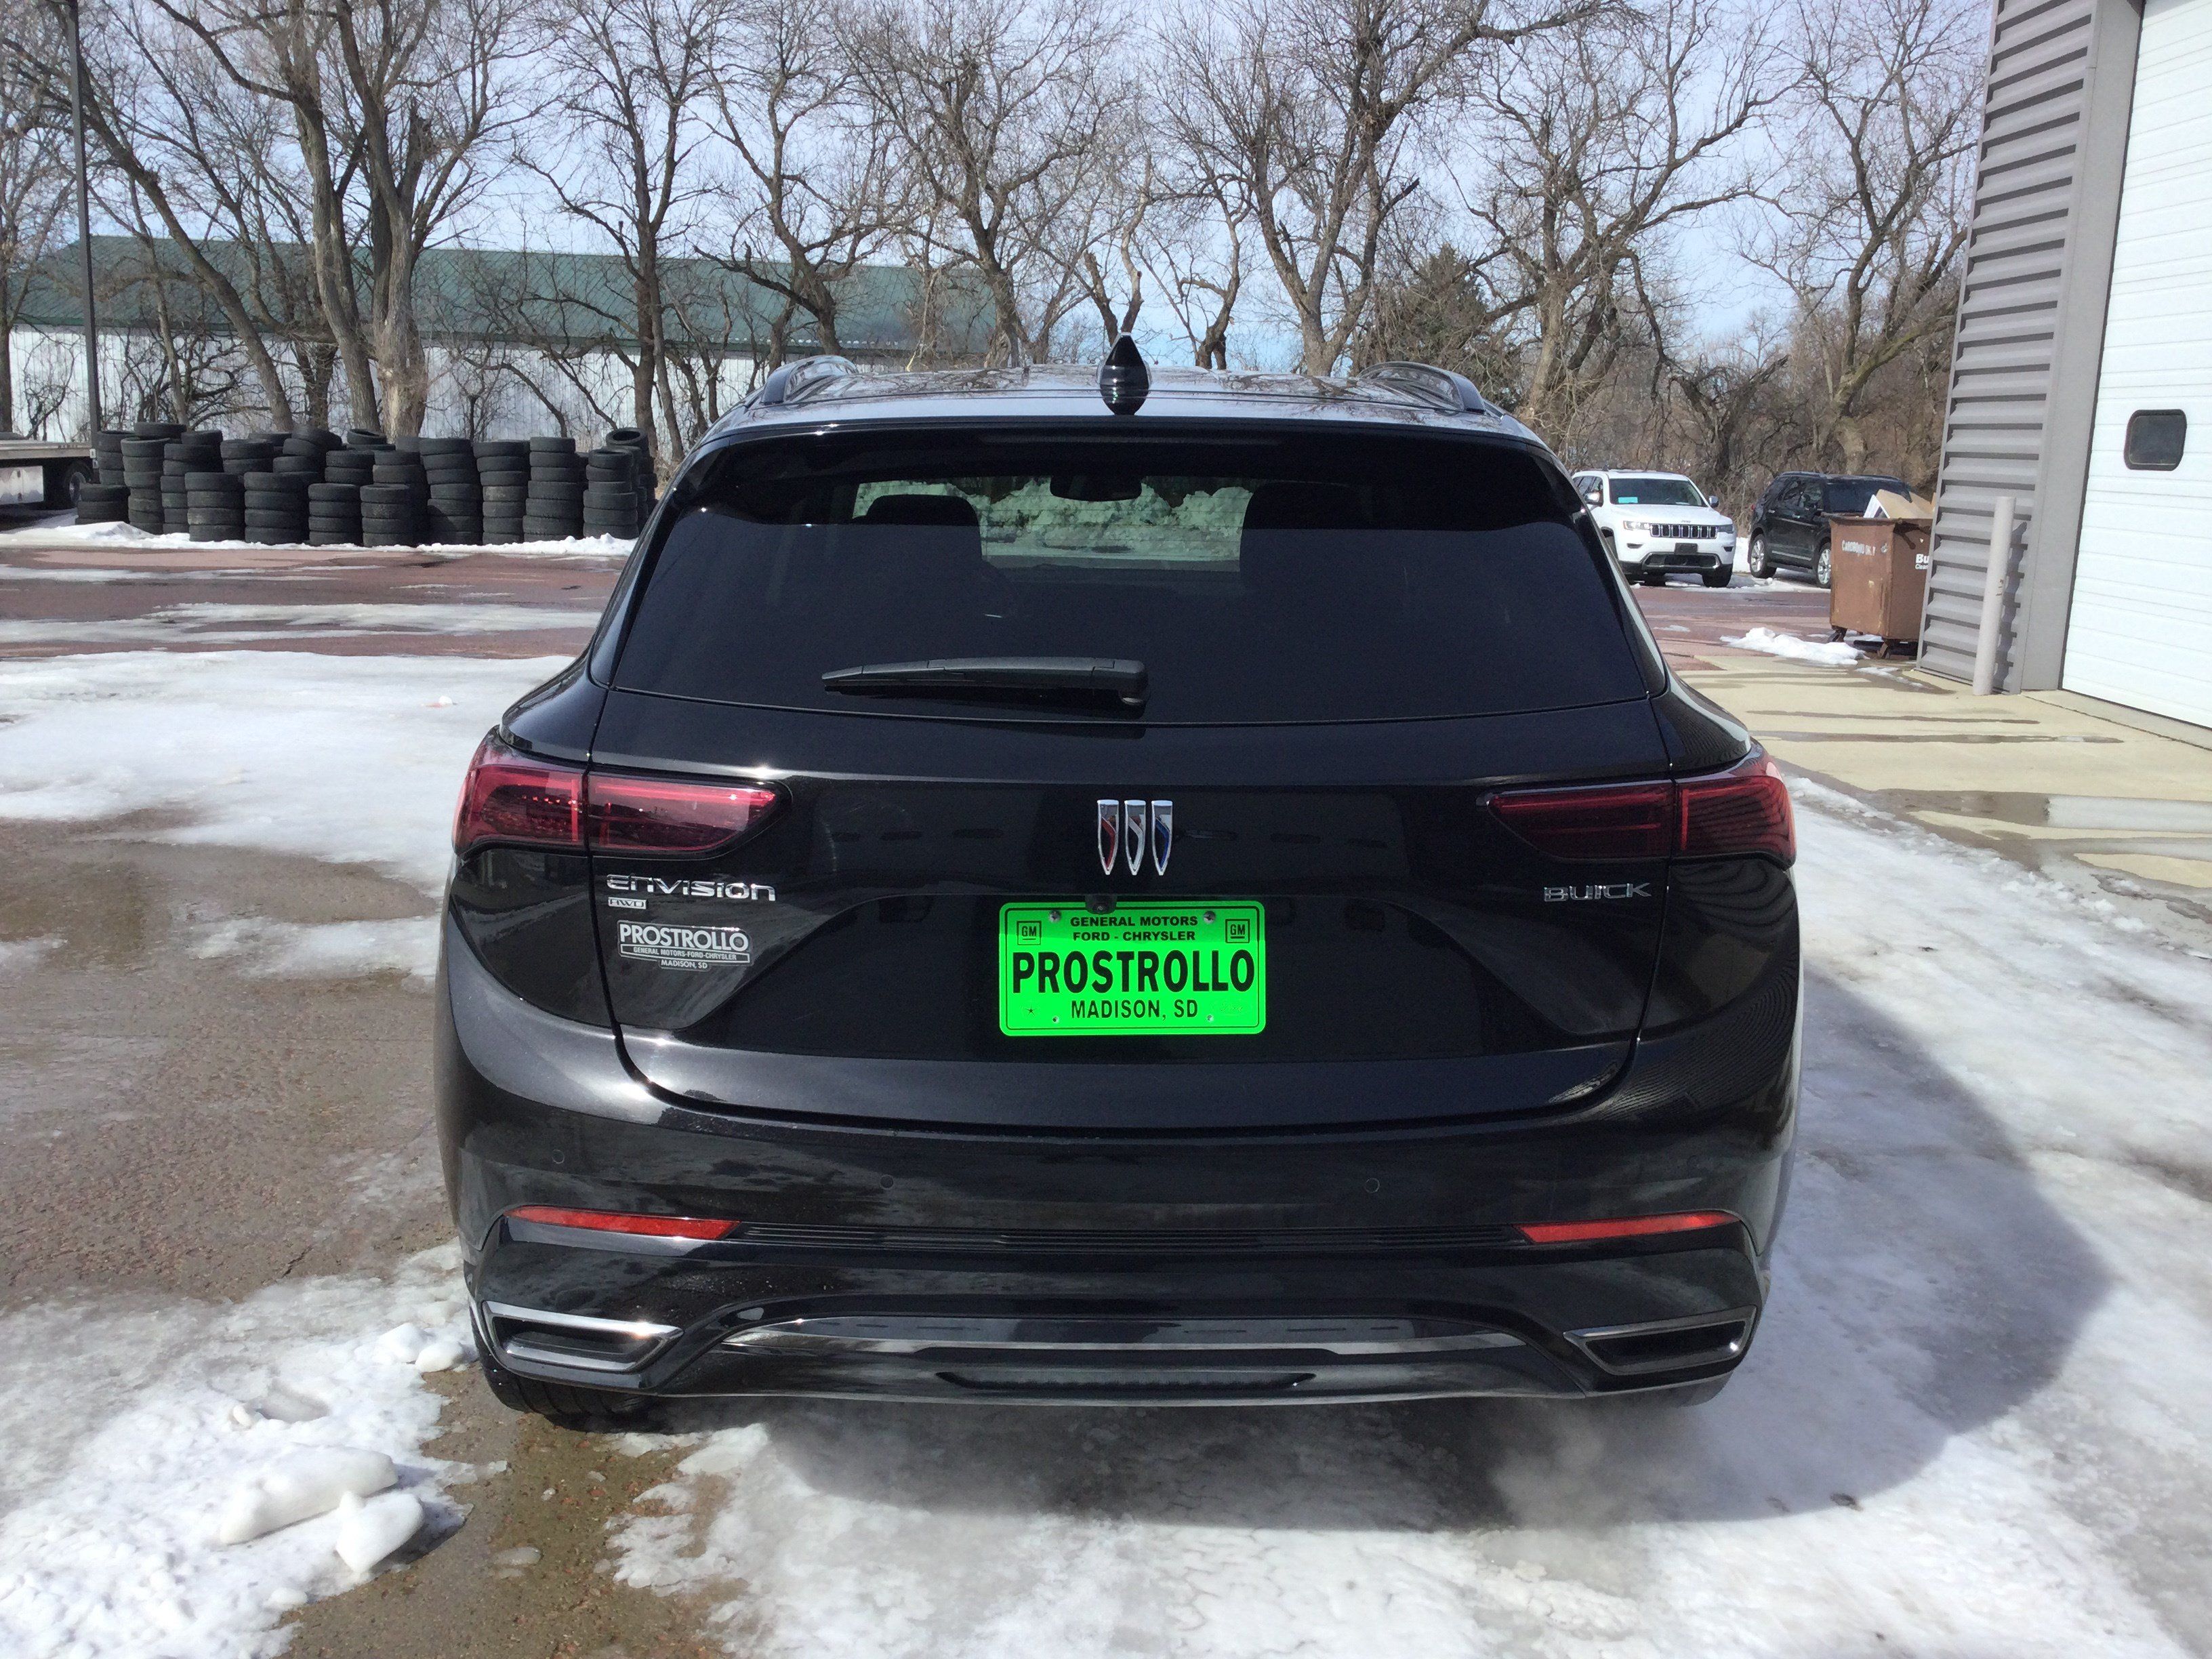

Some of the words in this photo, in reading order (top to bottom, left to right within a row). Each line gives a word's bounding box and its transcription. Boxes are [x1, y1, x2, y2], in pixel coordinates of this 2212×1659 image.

[1544, 882, 1652, 902] BUICK
[609, 899, 644, 909] AWD
[1070, 916, 1136, 927] GENERAL
[1140, 916, 1198, 926] MOTORS
[1021, 925, 1037, 937] GM
[1073, 932, 1109, 941] FORD
[1123, 931, 1195, 941] CHRYSLER
[1229, 924, 1246, 936] GM
[619, 924, 749, 951] PROSTROLLO
[633, 946, 659, 955] GENERAL
[661, 959, 696, 969] MADISON,
[1012, 949, 1255, 994] PROSTROLLO
[1071, 999, 1166, 1021] MADISON,
[1174, 999, 1198, 1018] SD
